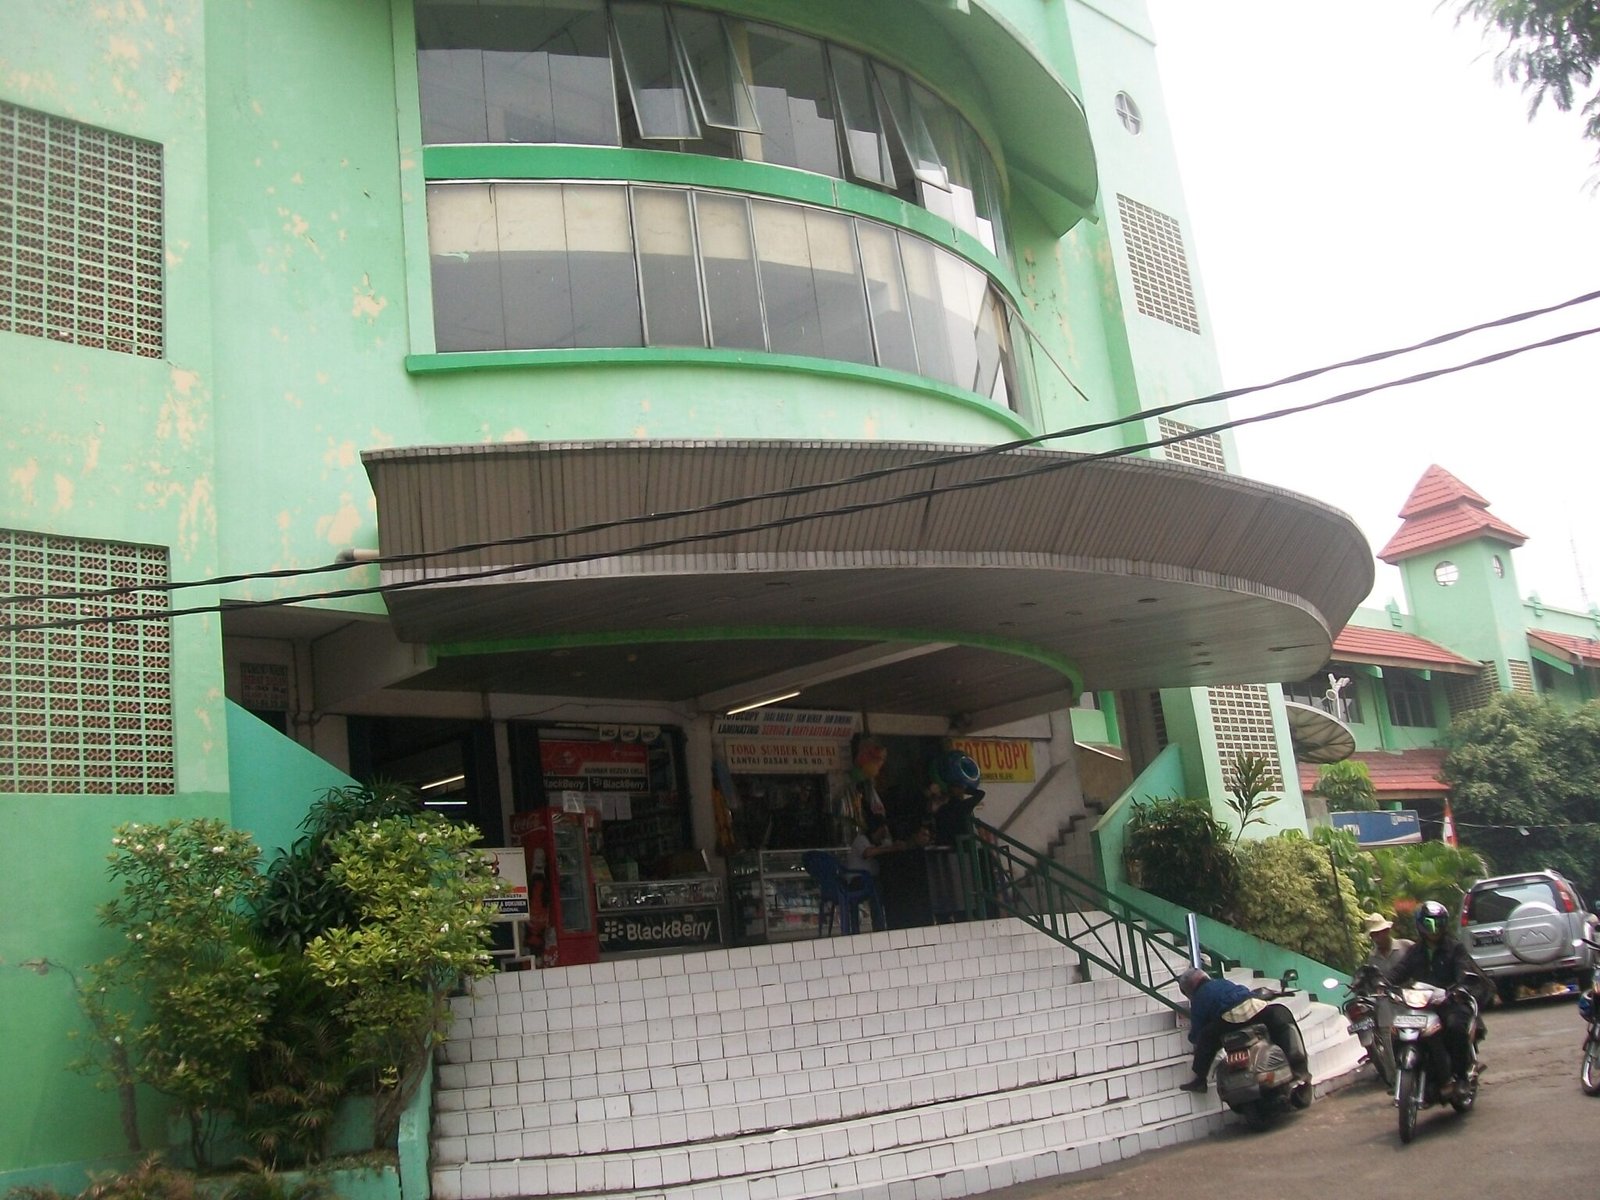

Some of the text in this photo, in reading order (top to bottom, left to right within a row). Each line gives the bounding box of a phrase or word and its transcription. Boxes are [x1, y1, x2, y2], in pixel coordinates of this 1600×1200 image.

[730, 744, 756, 756] TOKO
[760, 745, 798, 757] SUMBER
[995, 741, 1029, 770] COPY
[603, 777, 645, 791] BlackBerry
[627, 919, 712, 942] BlackBerry
